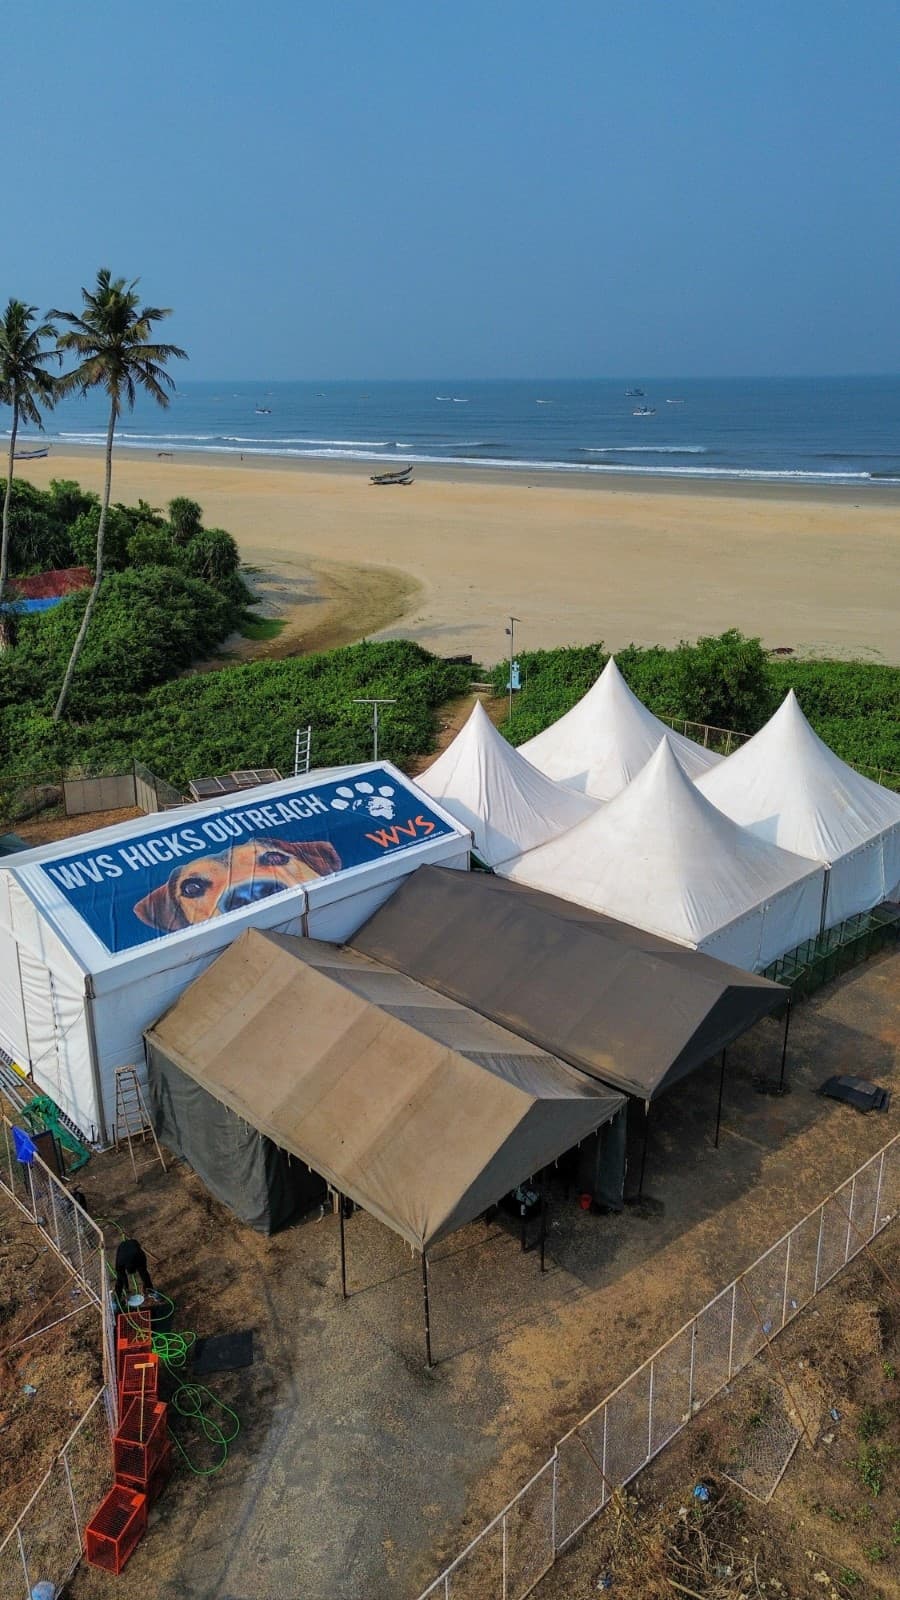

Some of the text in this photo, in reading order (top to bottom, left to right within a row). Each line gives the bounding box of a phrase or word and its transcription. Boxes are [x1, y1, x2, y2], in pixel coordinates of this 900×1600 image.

[48, 793, 329, 890] WVS HICKS OUTREACH
[365, 815, 436, 848] WVS
